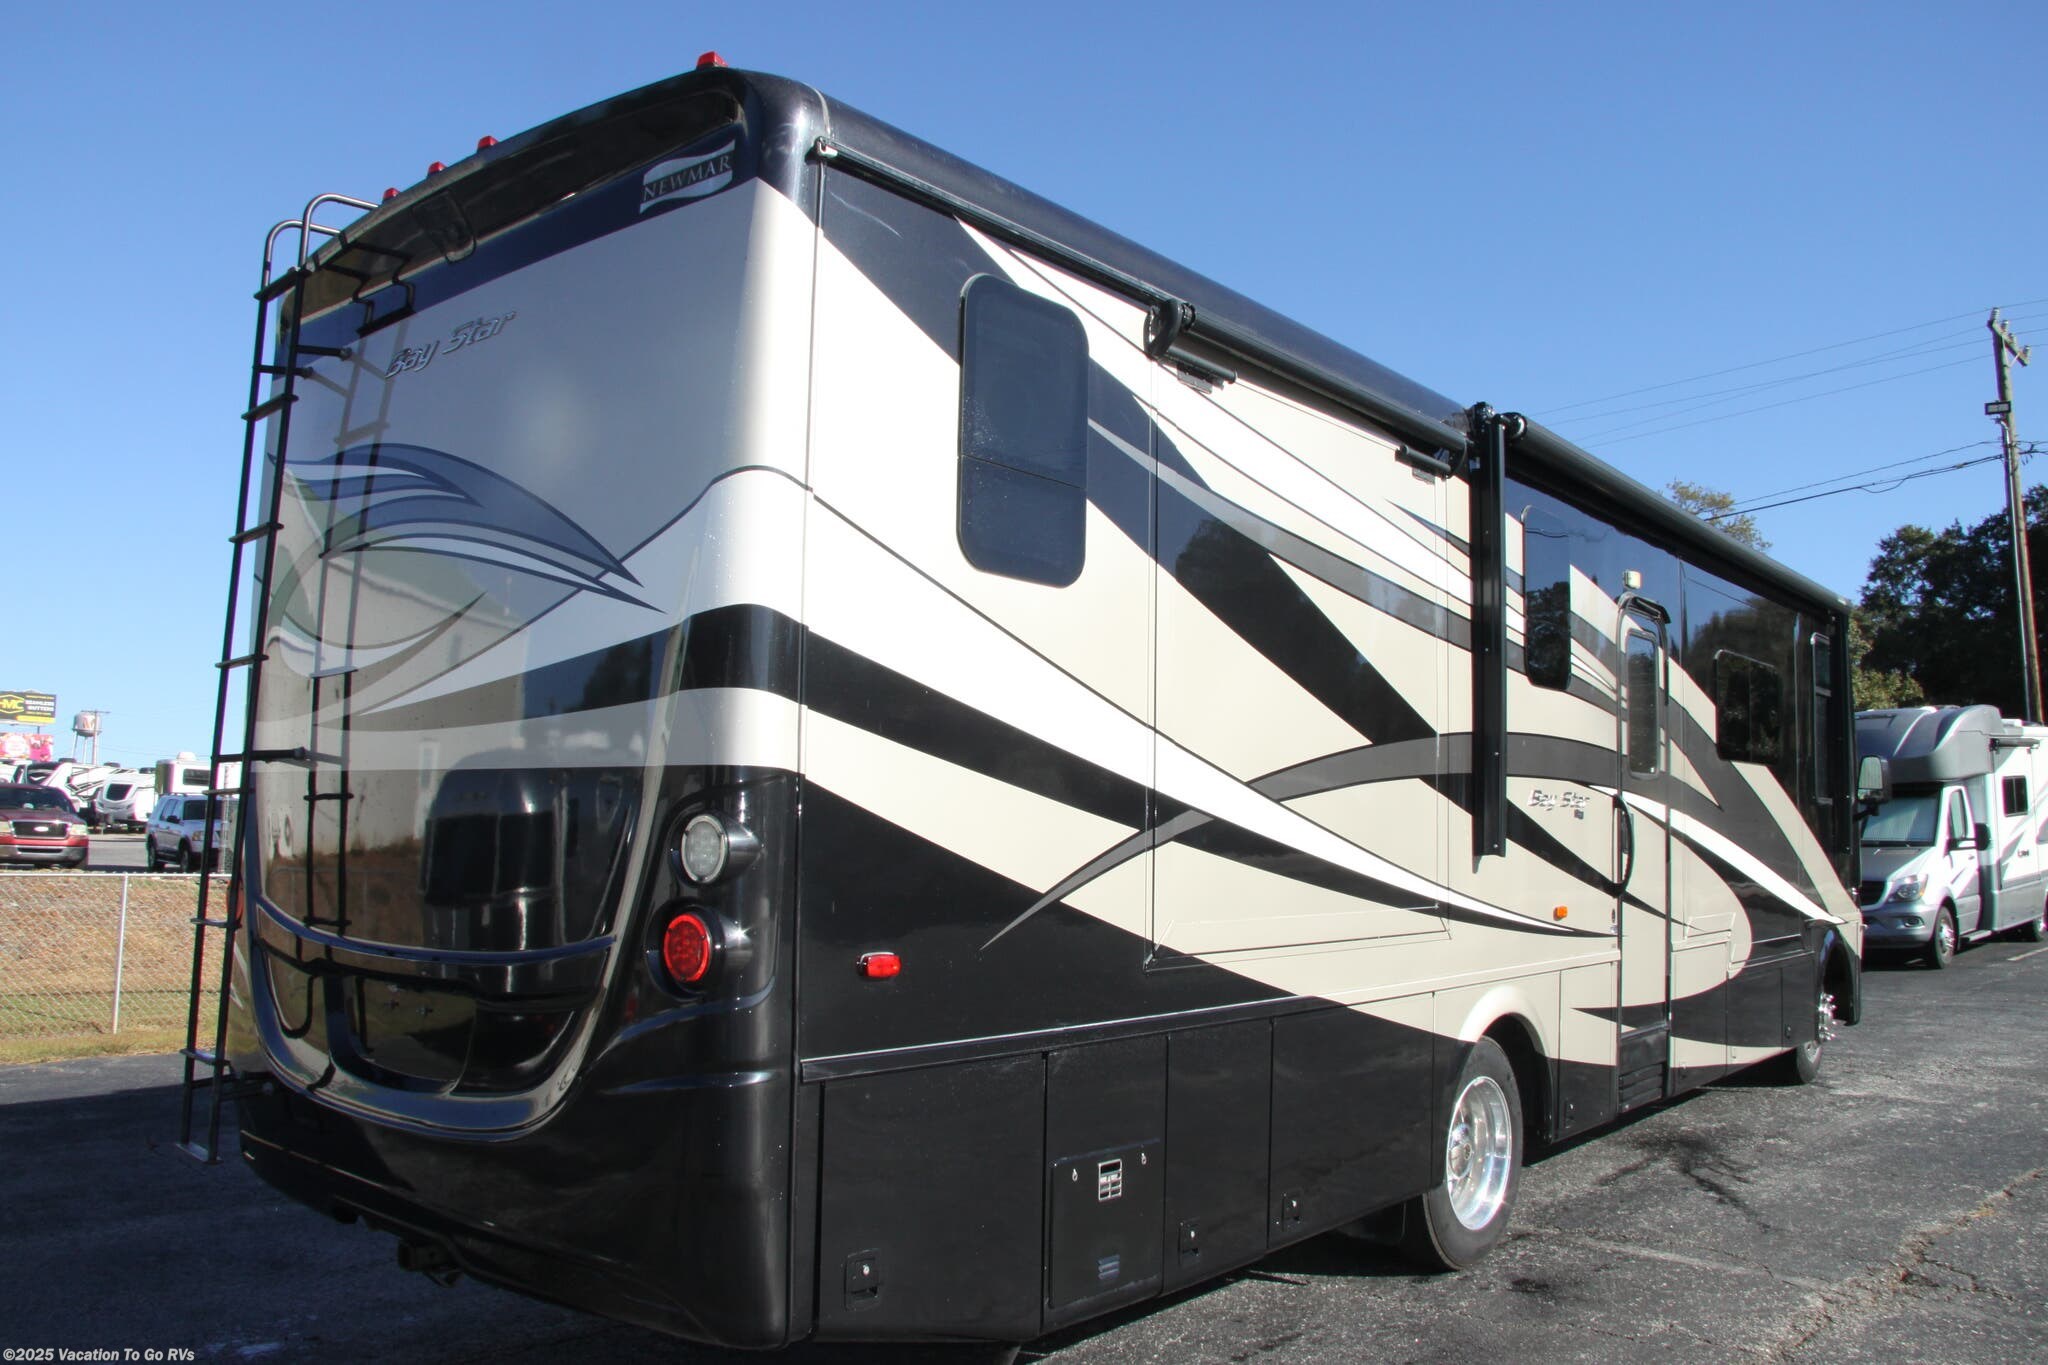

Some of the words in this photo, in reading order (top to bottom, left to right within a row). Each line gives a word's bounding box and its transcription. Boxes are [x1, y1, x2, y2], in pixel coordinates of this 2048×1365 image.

[643, 155, 731, 202] NEWMAR
[384, 340, 440, 380] Bay
[442, 311, 516, 355] Star
